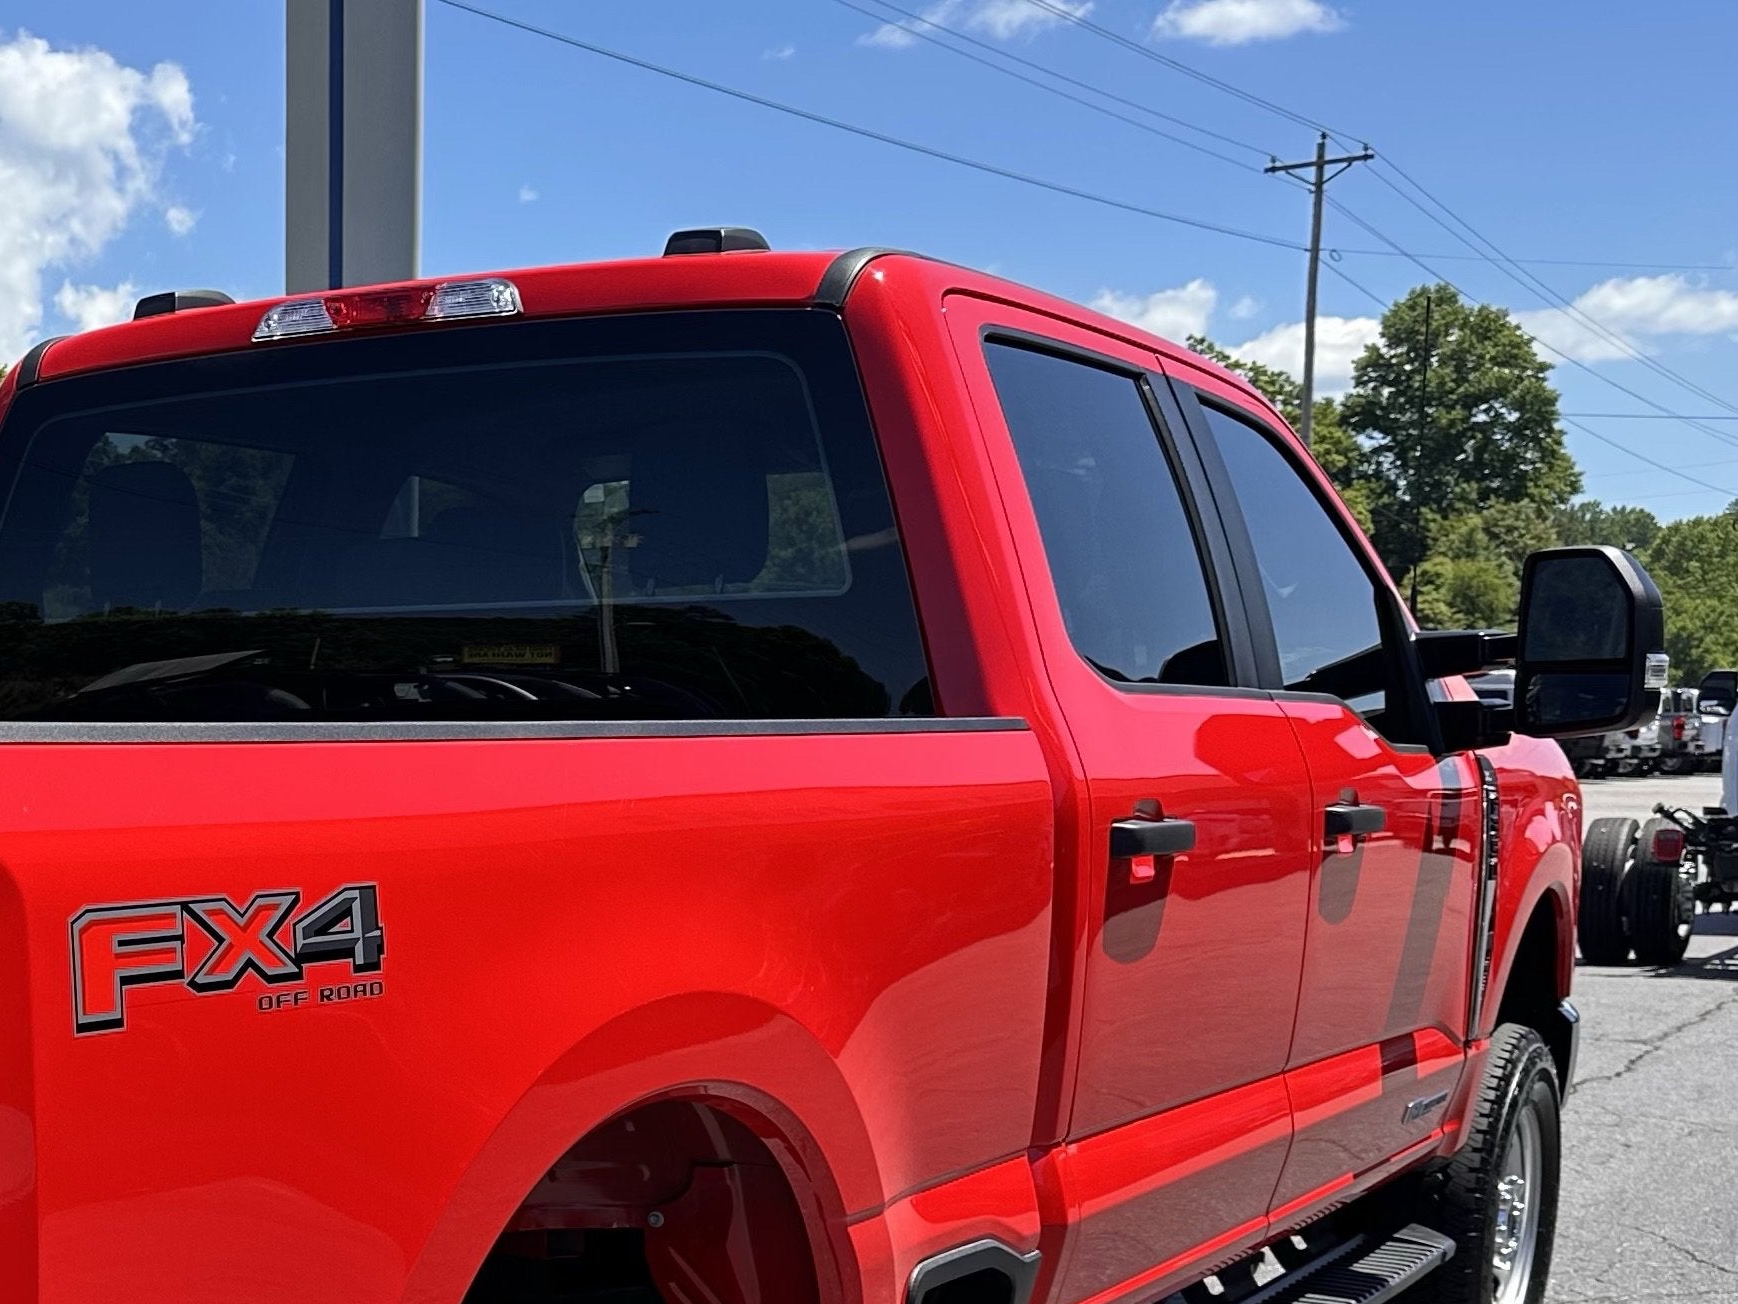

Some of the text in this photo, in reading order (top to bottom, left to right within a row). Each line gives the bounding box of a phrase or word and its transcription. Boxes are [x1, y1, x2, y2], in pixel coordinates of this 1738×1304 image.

[68, 882, 387, 1038] FX4
[257, 981, 385, 1013] OFF ROAD
